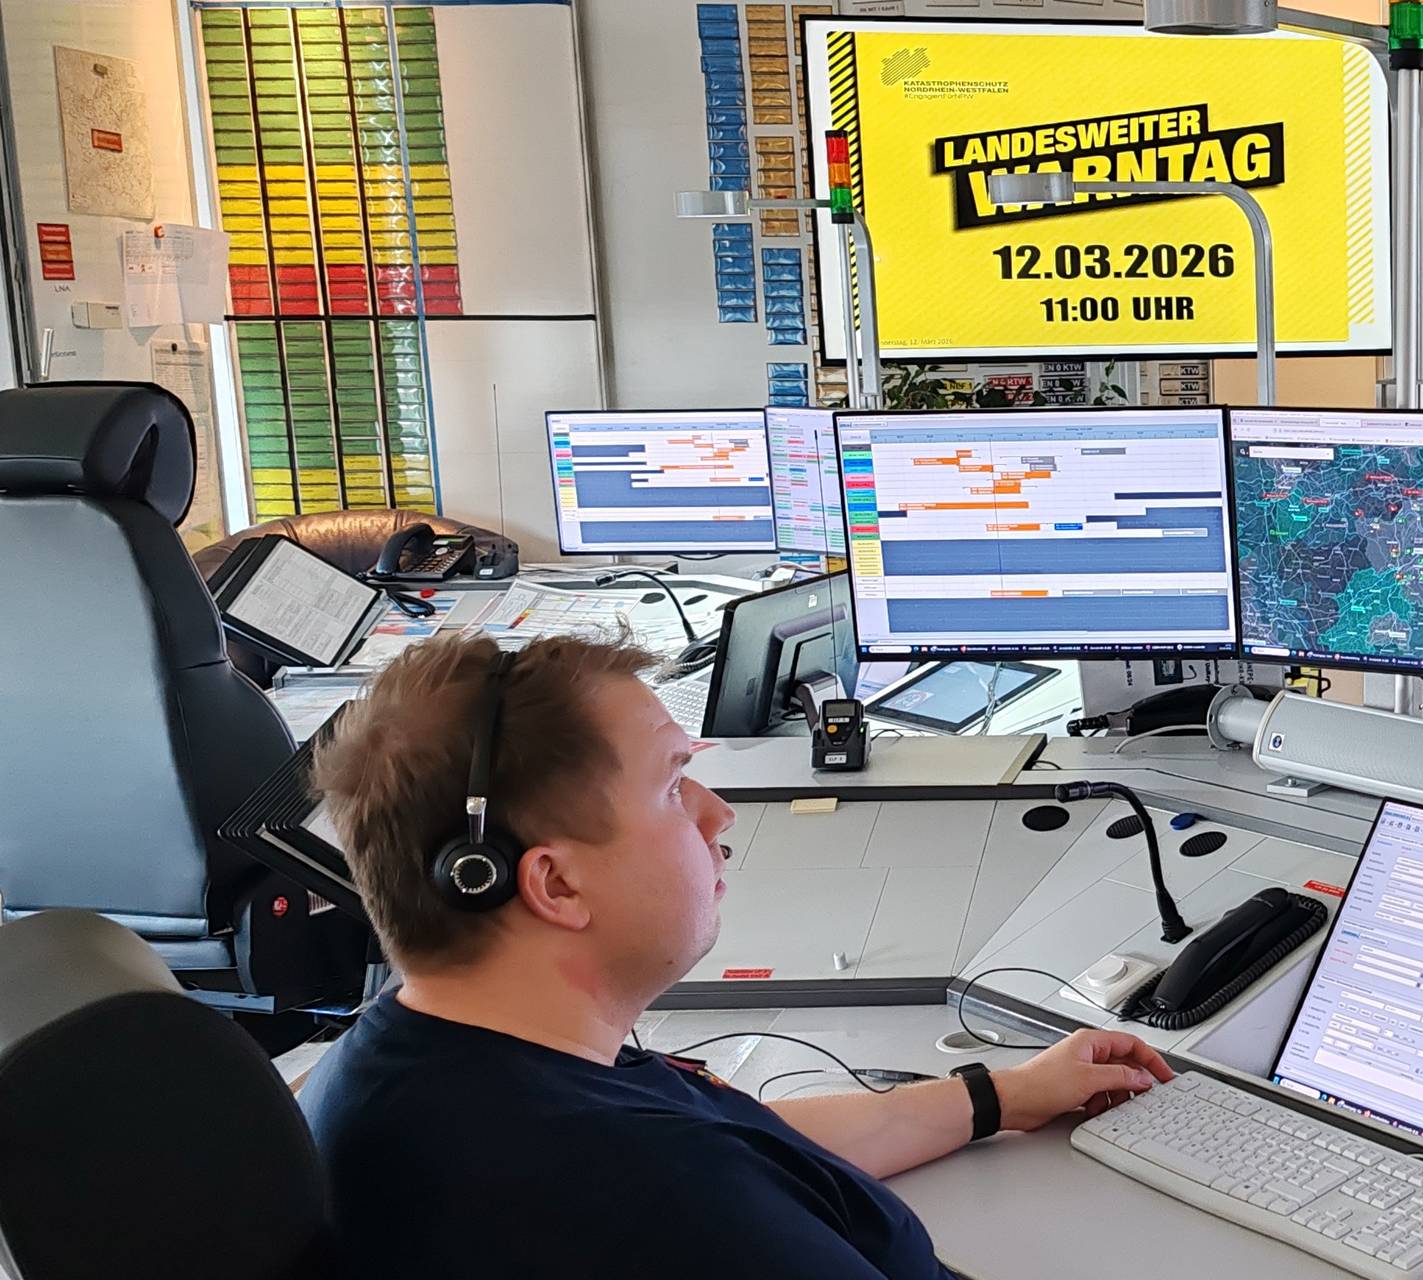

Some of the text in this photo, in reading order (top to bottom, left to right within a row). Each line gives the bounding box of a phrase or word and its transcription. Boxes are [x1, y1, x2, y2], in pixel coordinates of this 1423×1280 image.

[943, 108, 1202, 168] LANDESWEITER
[992, 243, 1235, 280] 12.03.2026
[1039, 296, 1195, 322] 11:00 UHR
[1062, 363, 1082, 371] KTW
[1181, 366, 1200, 375] KTW
[1181, 382, 1200, 391] KTW
